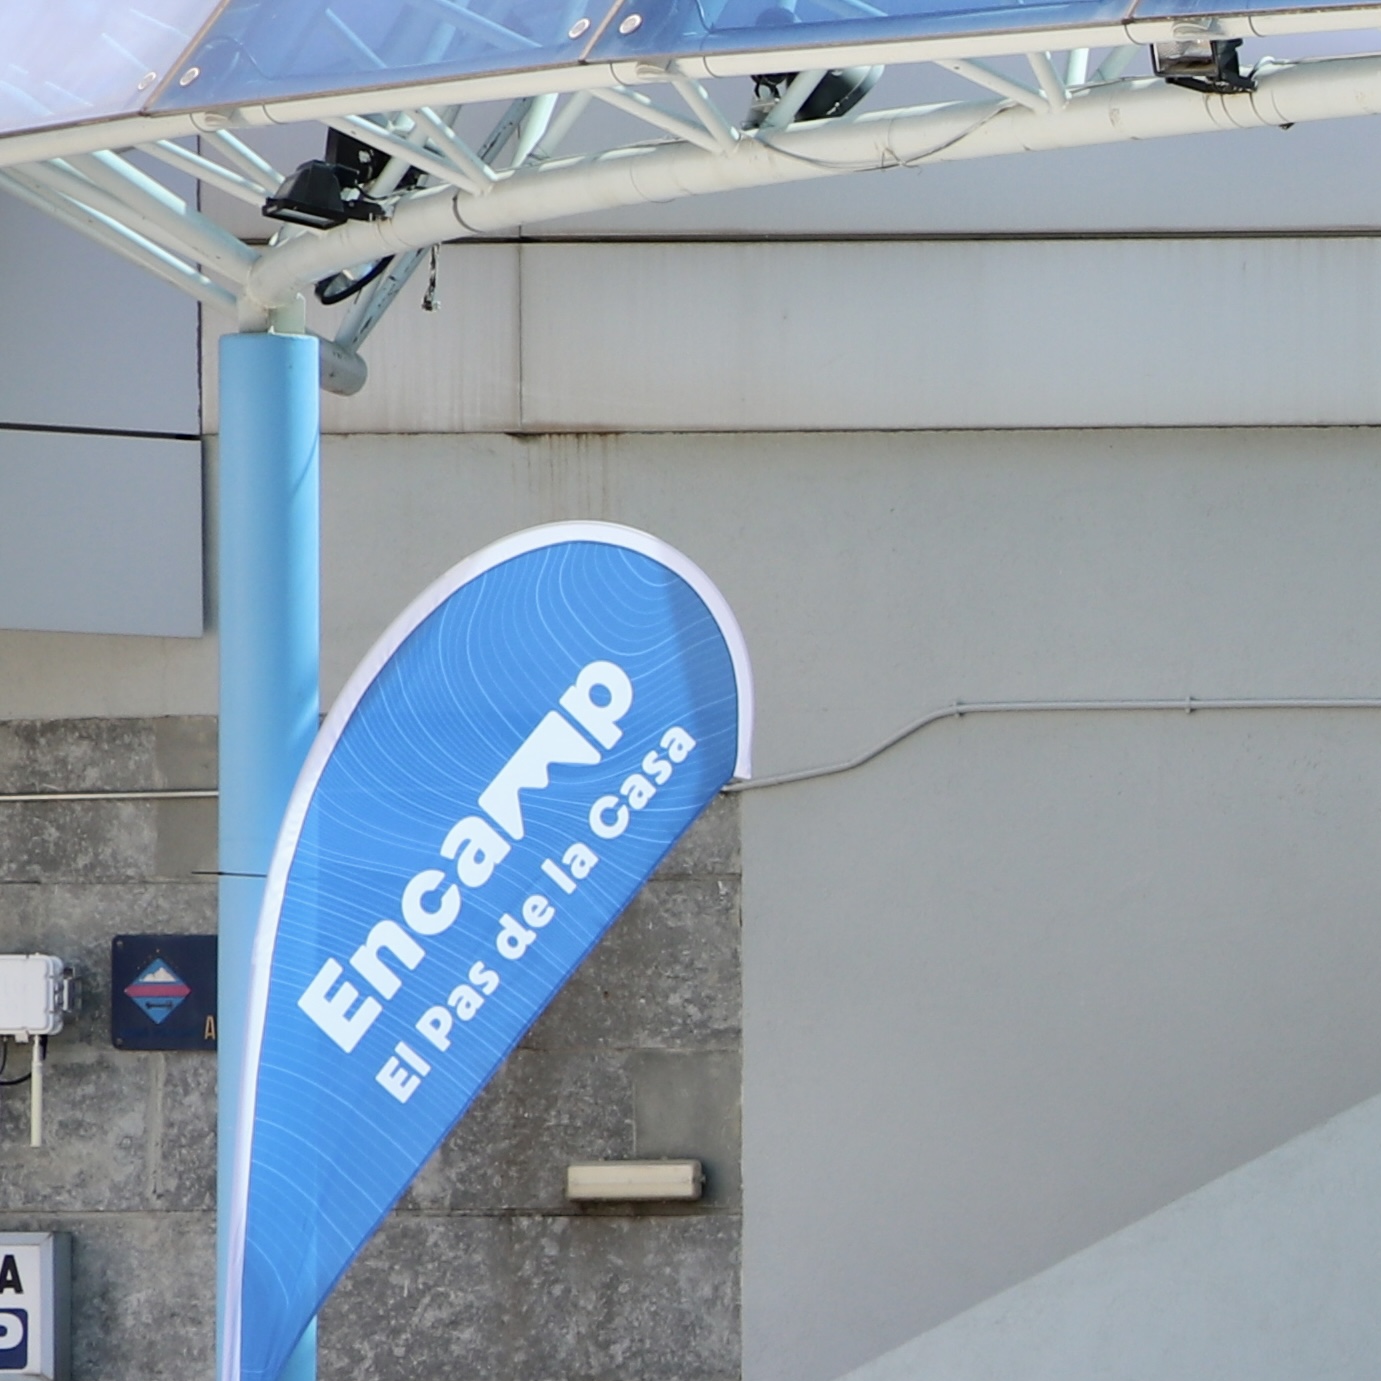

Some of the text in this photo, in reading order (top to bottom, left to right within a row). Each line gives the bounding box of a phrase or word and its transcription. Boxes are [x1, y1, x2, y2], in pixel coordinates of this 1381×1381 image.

[298, 660, 633, 1053] Encamp
[375, 726, 696, 1103] El Pas de la Casa
